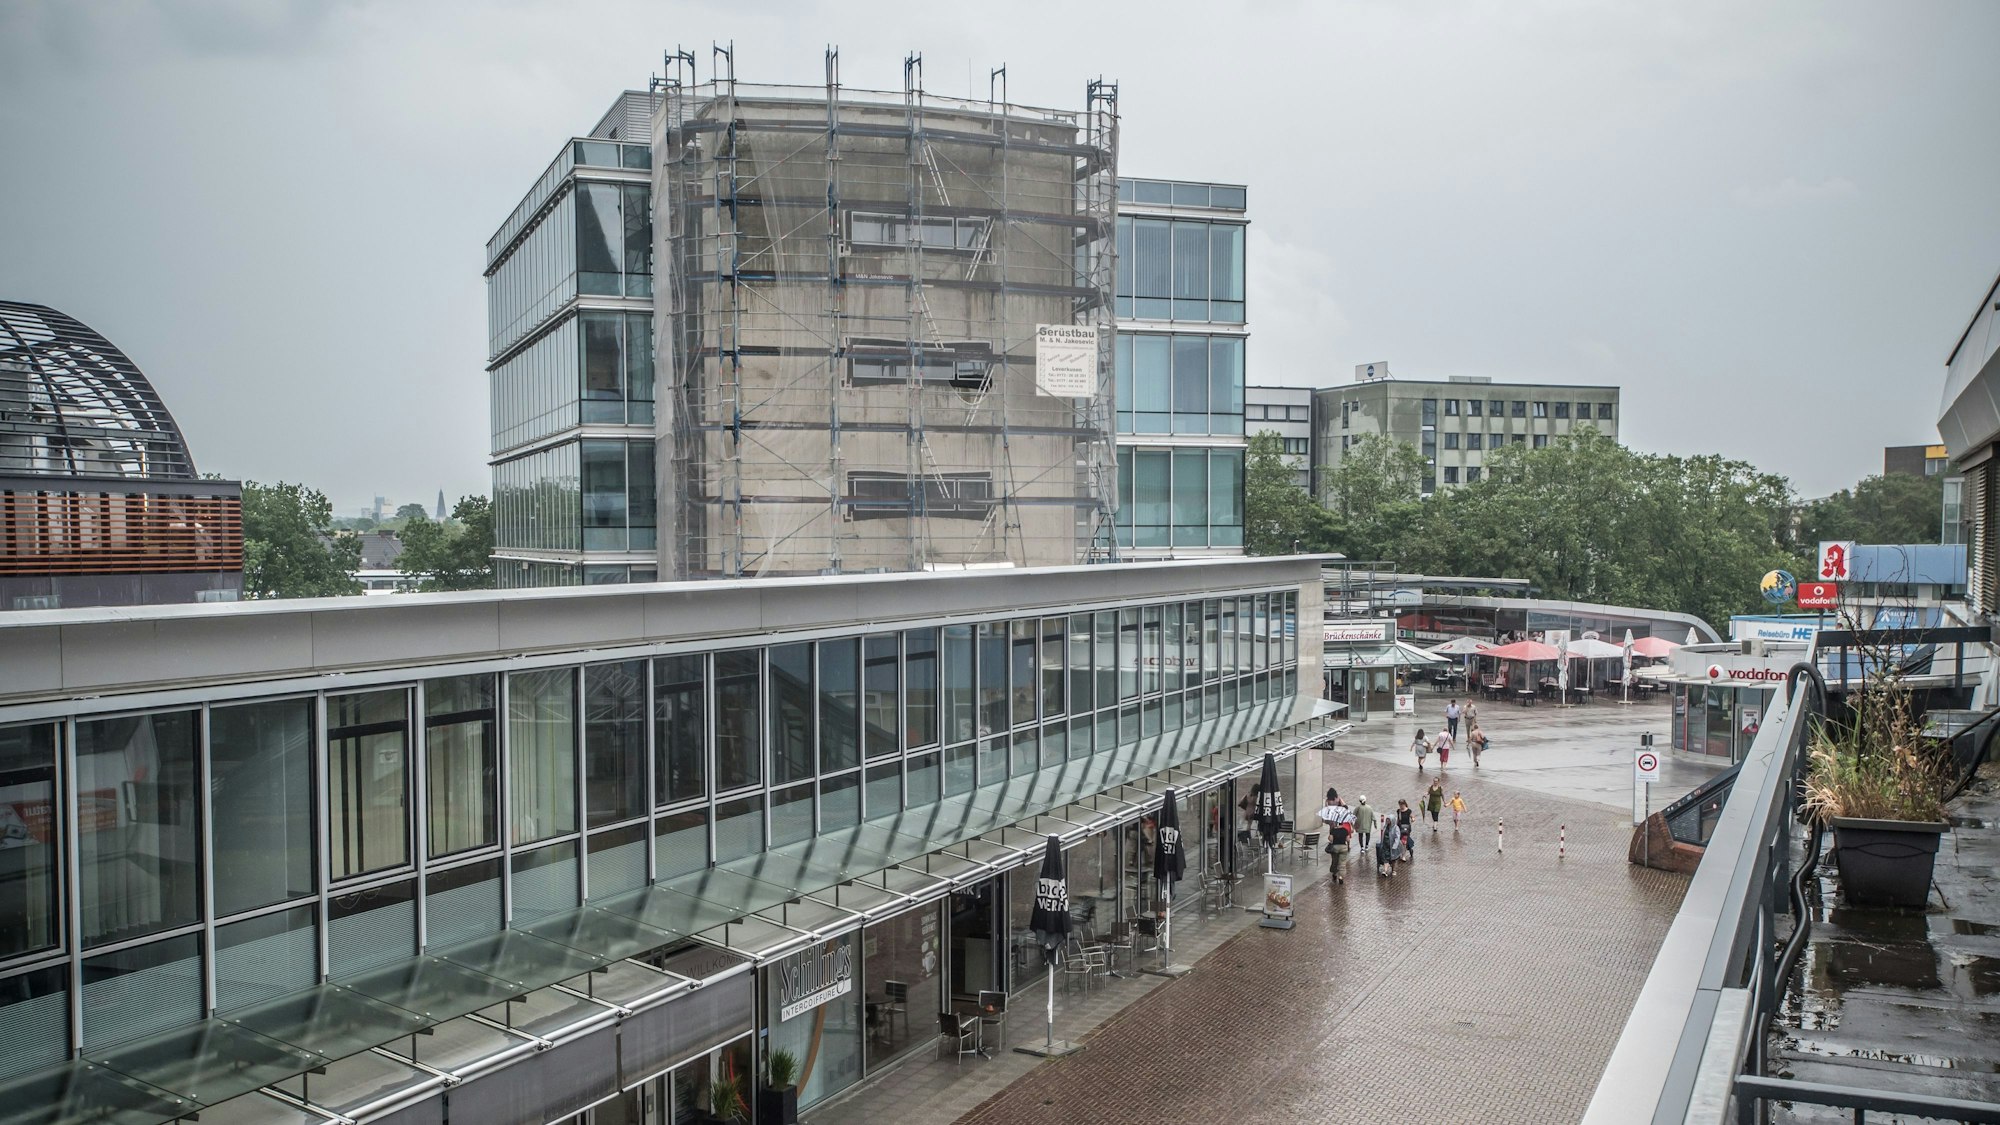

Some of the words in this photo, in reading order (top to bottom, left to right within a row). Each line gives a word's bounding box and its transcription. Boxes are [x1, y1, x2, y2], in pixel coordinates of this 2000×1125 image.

[1040, 326, 1094, 338] Gerüstbau
[1324, 629, 1382, 640] Brückenschänke
[1758, 630, 1790, 639] Reisebüro
[1728, 667, 1789, 681] vodafon
[781, 943, 852, 1006] Schillings
[783, 987, 836, 1019] INTERCOIFFURE
